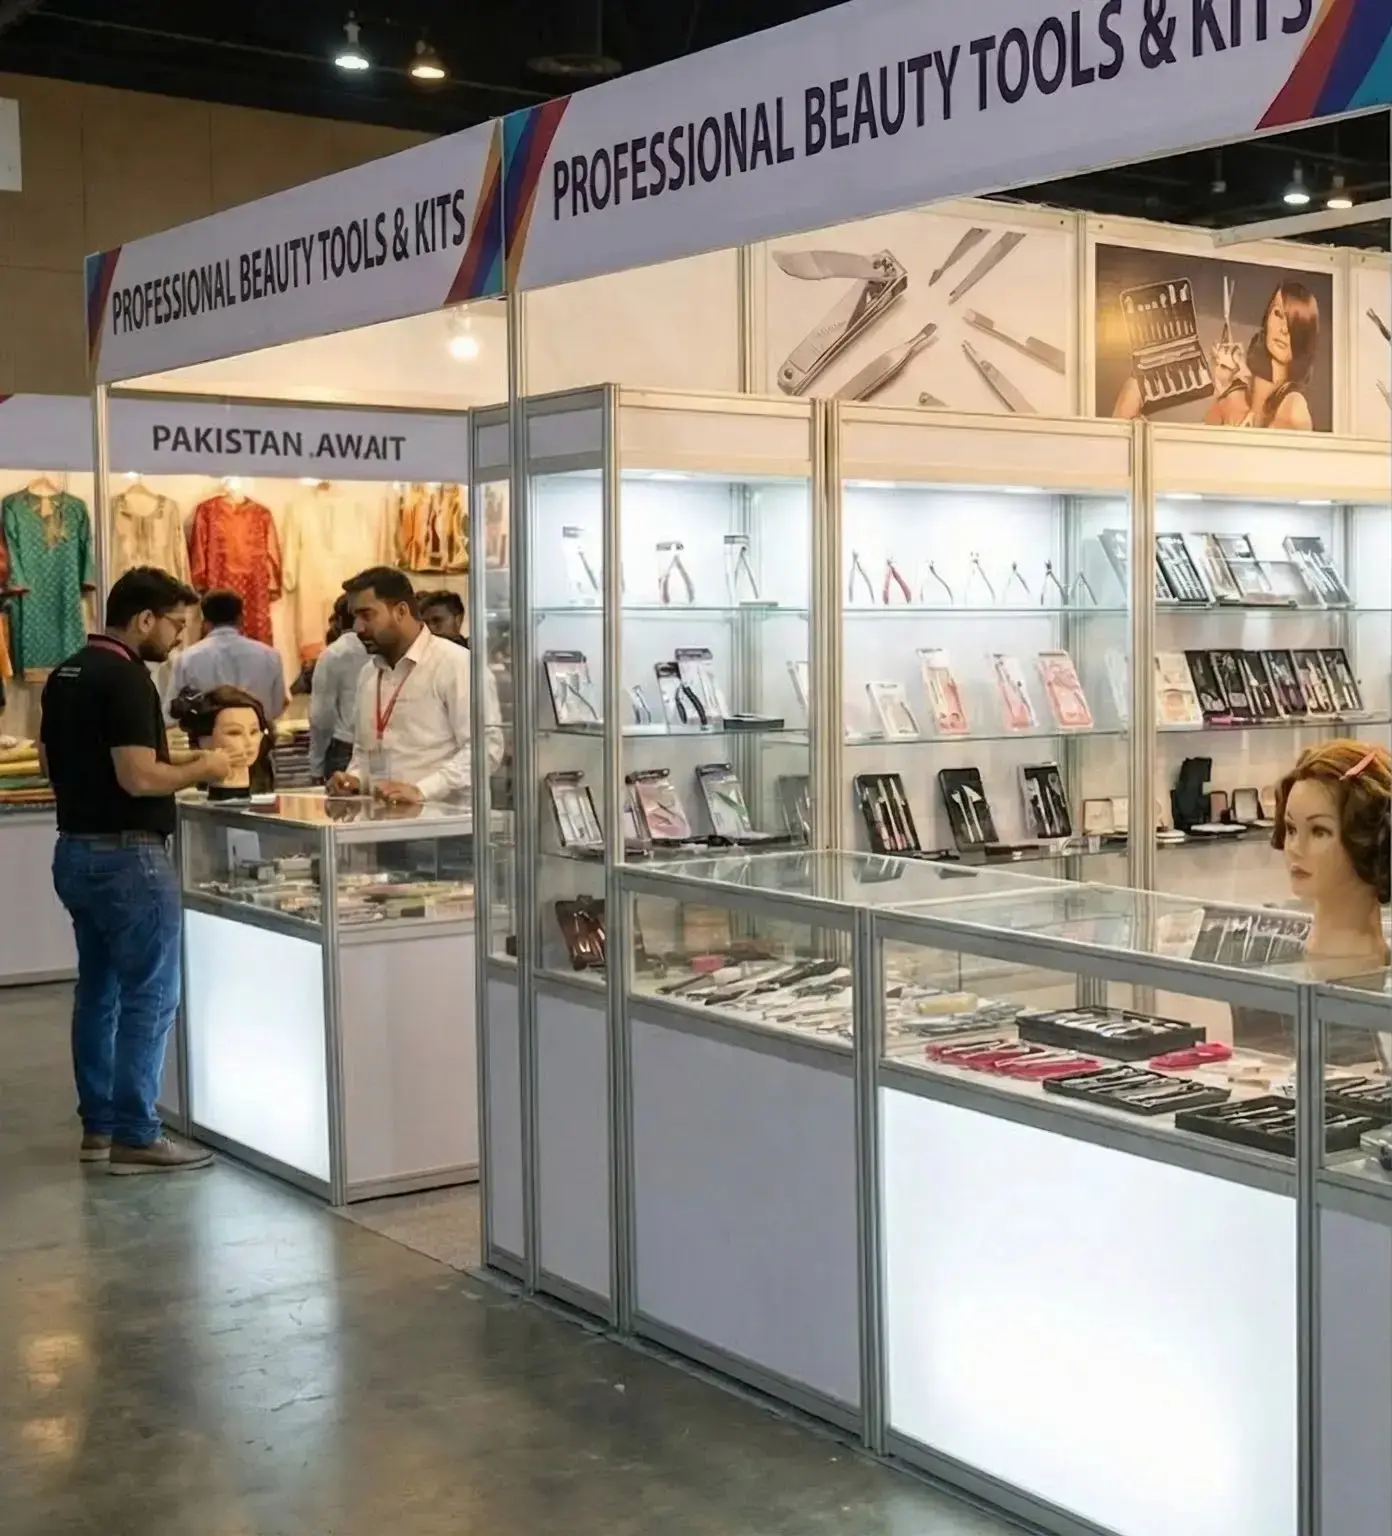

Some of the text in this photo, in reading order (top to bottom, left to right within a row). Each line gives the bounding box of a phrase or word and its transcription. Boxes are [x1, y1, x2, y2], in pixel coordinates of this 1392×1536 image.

[553, 97, 795, 221] PROFESSIONAL
[804, 45, 961, 157] BEAUTY
[969, 0, 1124, 112] TOOLS
[1139, 0, 1177, 69] &
[112, 188, 466, 335] PROFESSIONAL BEAUTY TOOLS & KITS
[152, 425, 303, 457] PAKISTAN
